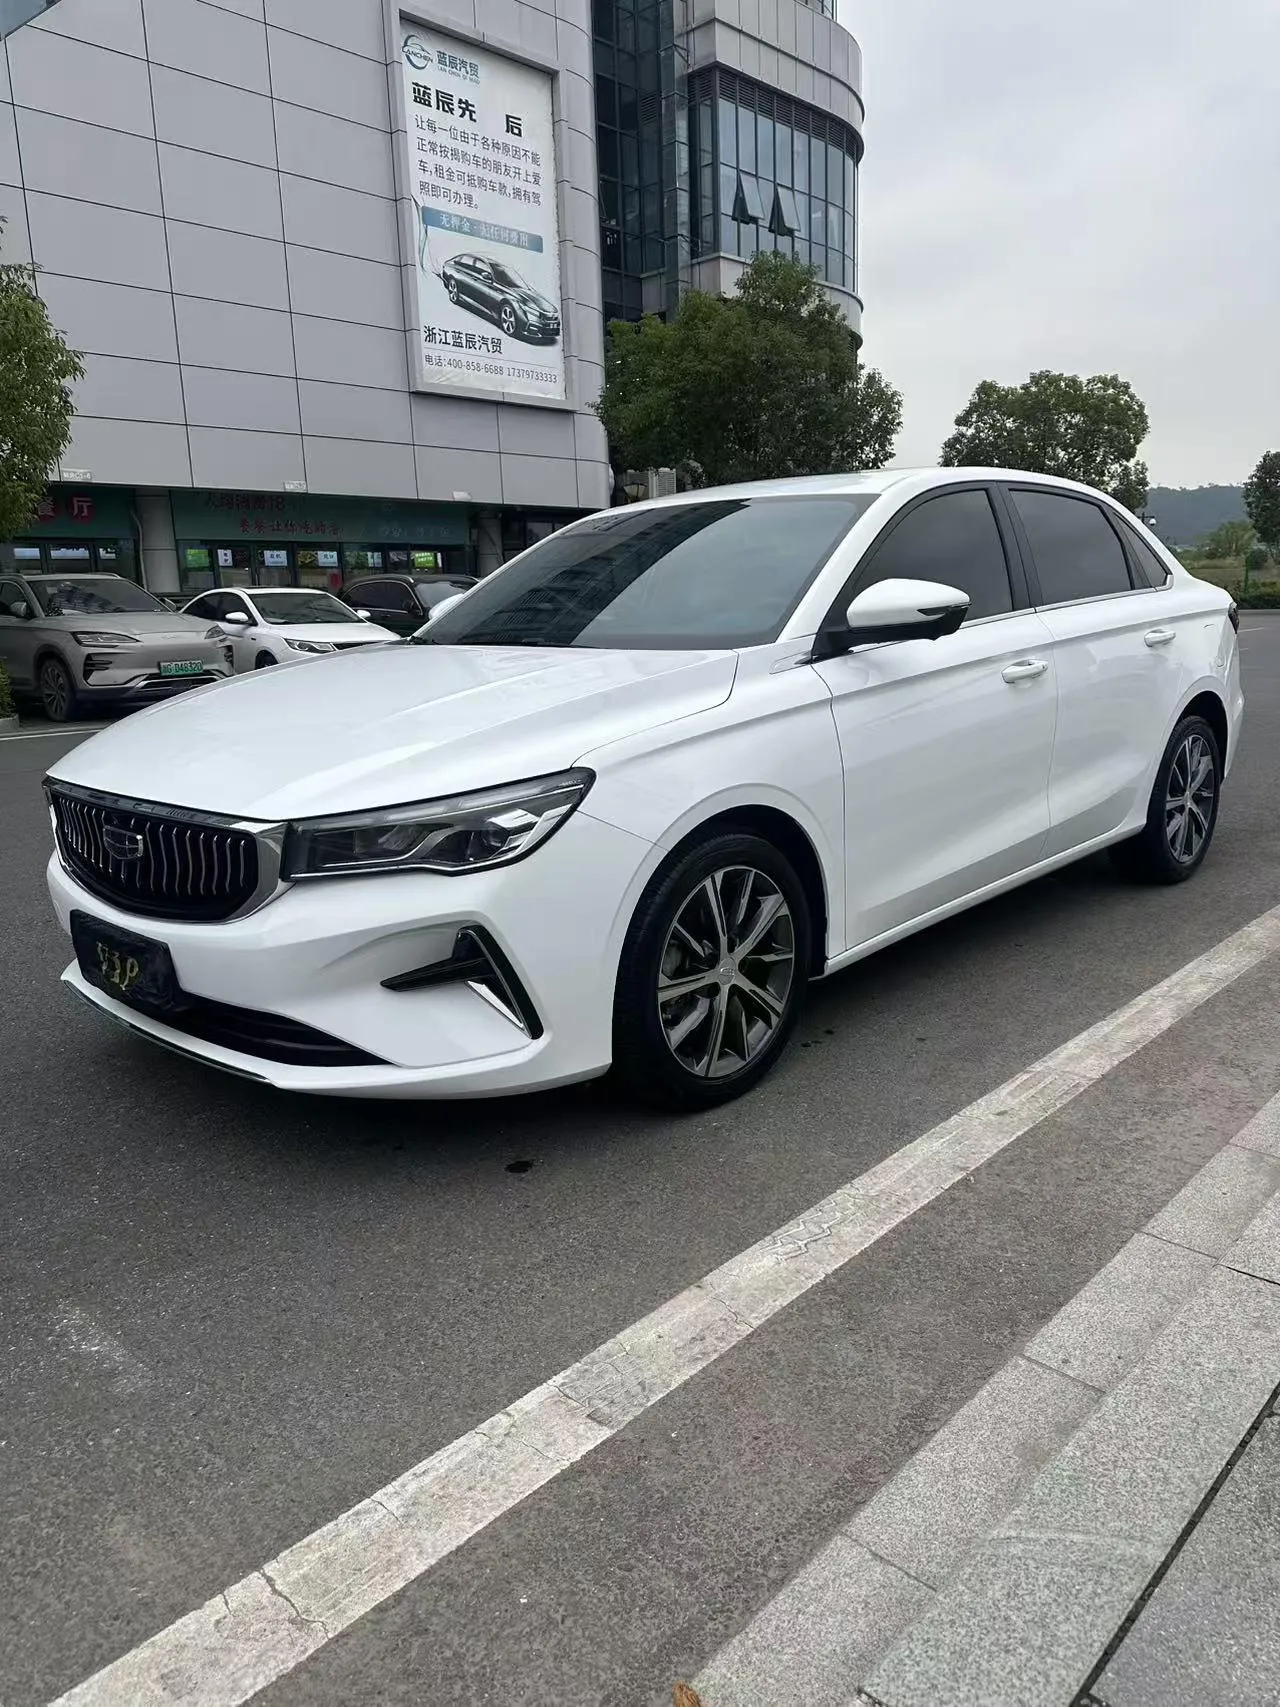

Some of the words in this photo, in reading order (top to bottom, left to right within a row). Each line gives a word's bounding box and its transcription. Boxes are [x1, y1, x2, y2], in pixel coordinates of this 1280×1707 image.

[437, 50, 480, 79] 蓝辰汽贸
[411, 81, 477, 123] 蓝辰先
[505, 113, 523, 137] 后
[415, 114, 541, 166] 让每一位由于各种原因不能
[416, 136, 542, 187] 正常按揭购车的朋友开上爱
[423, 324, 503, 354] 浙江蓝辰汽贸
[507, 366, 558, 384] 17379733333
